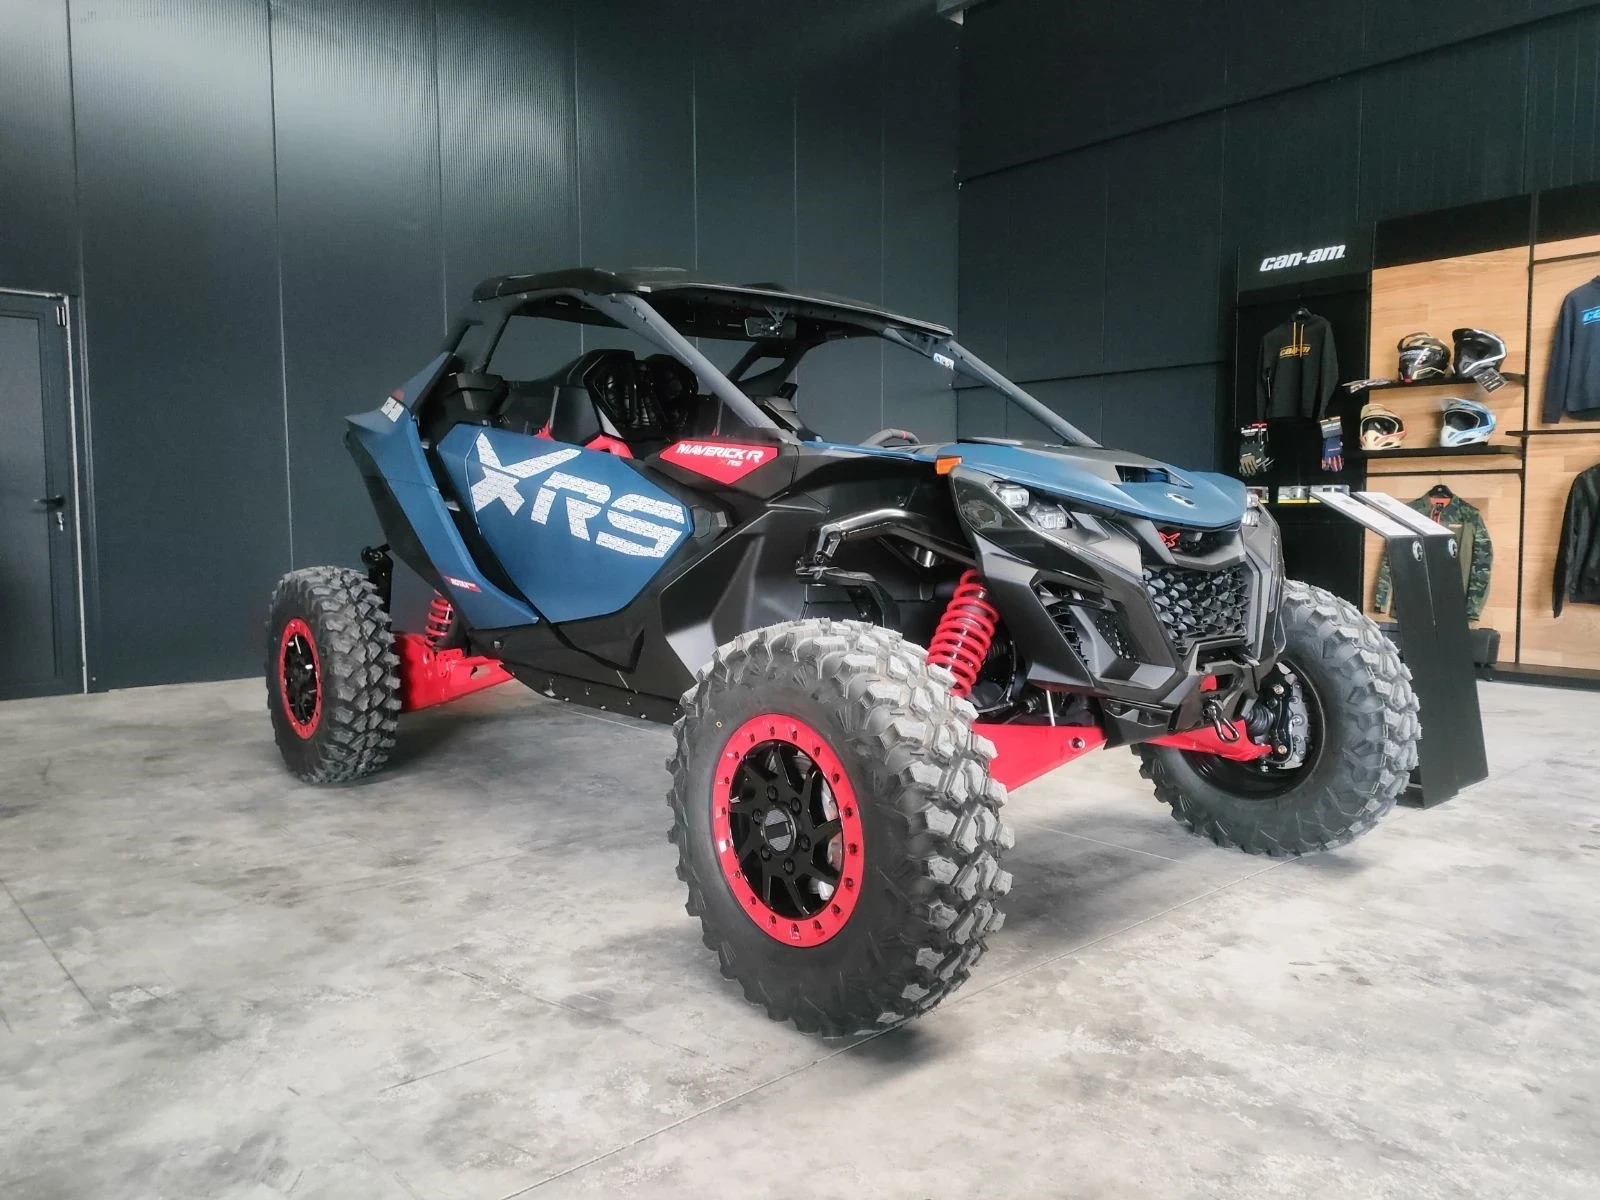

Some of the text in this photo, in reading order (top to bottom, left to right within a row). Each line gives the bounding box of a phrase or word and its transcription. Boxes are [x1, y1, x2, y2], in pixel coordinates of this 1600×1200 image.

[1259, 244, 1346, 272] can-am
[676, 444, 764, 463] MAVERICK R
[471, 432, 685, 558] XRS
